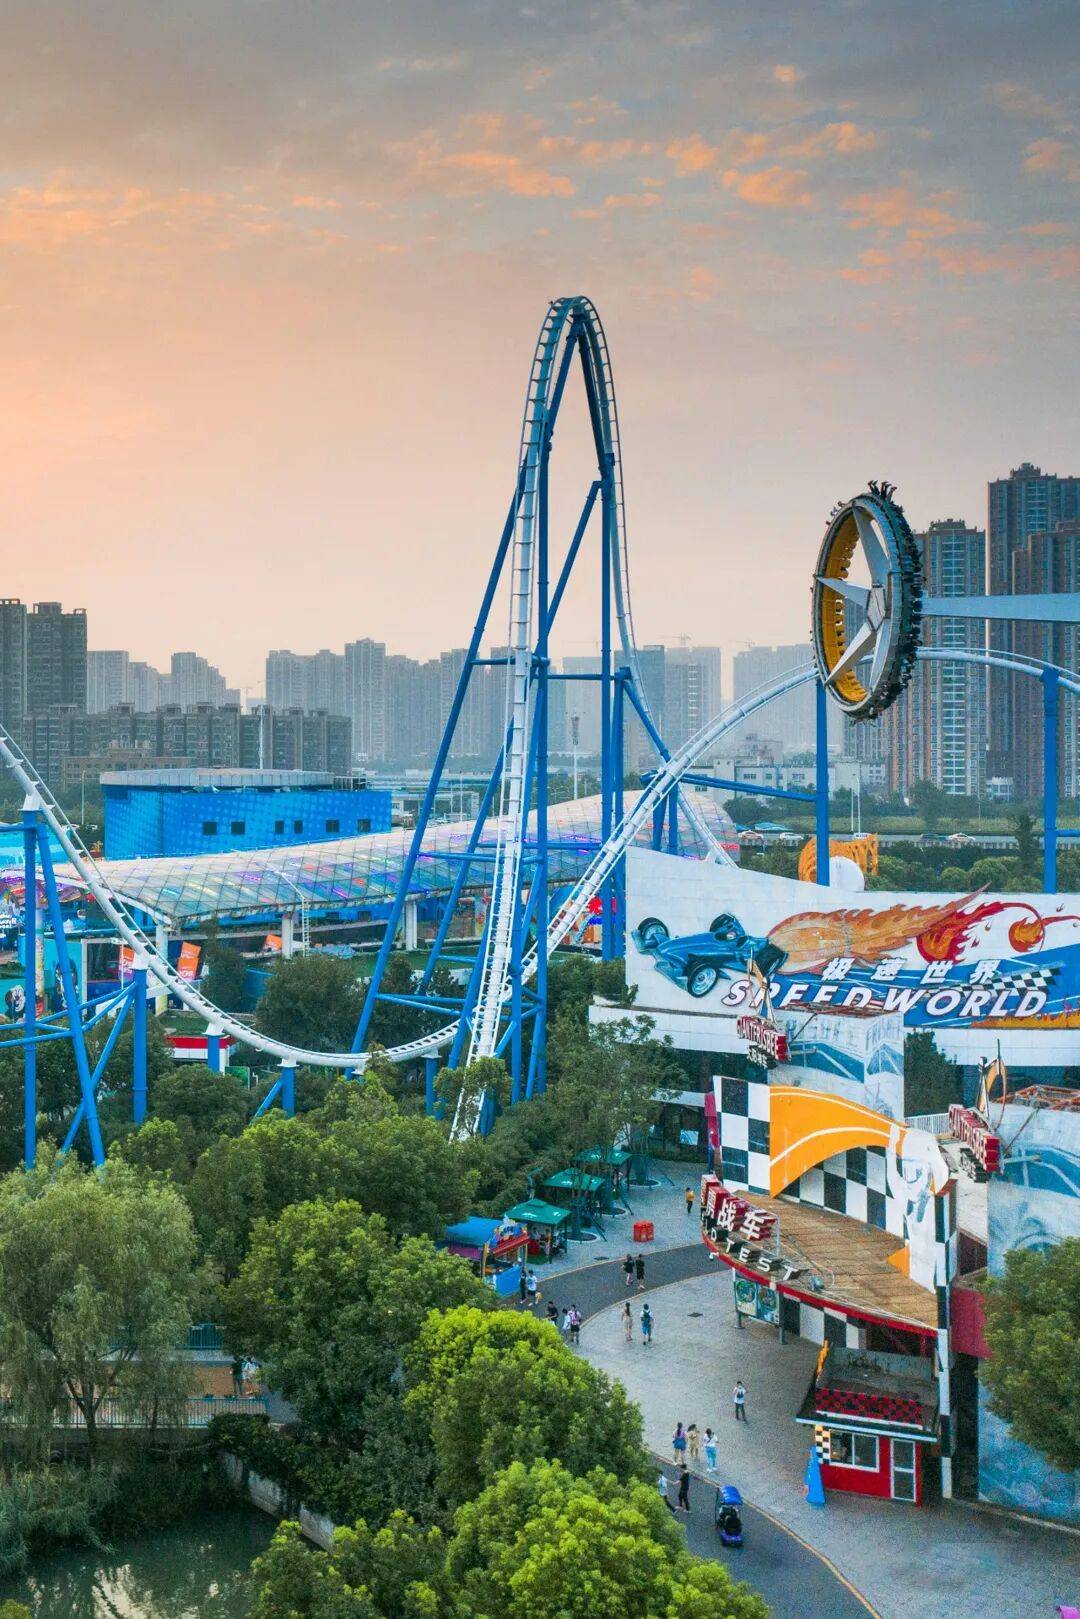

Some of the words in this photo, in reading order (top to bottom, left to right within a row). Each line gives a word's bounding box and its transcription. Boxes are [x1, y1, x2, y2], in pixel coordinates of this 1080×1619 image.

[821, 957, 1001, 985] 极速世界
[721, 979, 872, 1009] SPEED
[883, 988, 1047, 1018] WORLD
